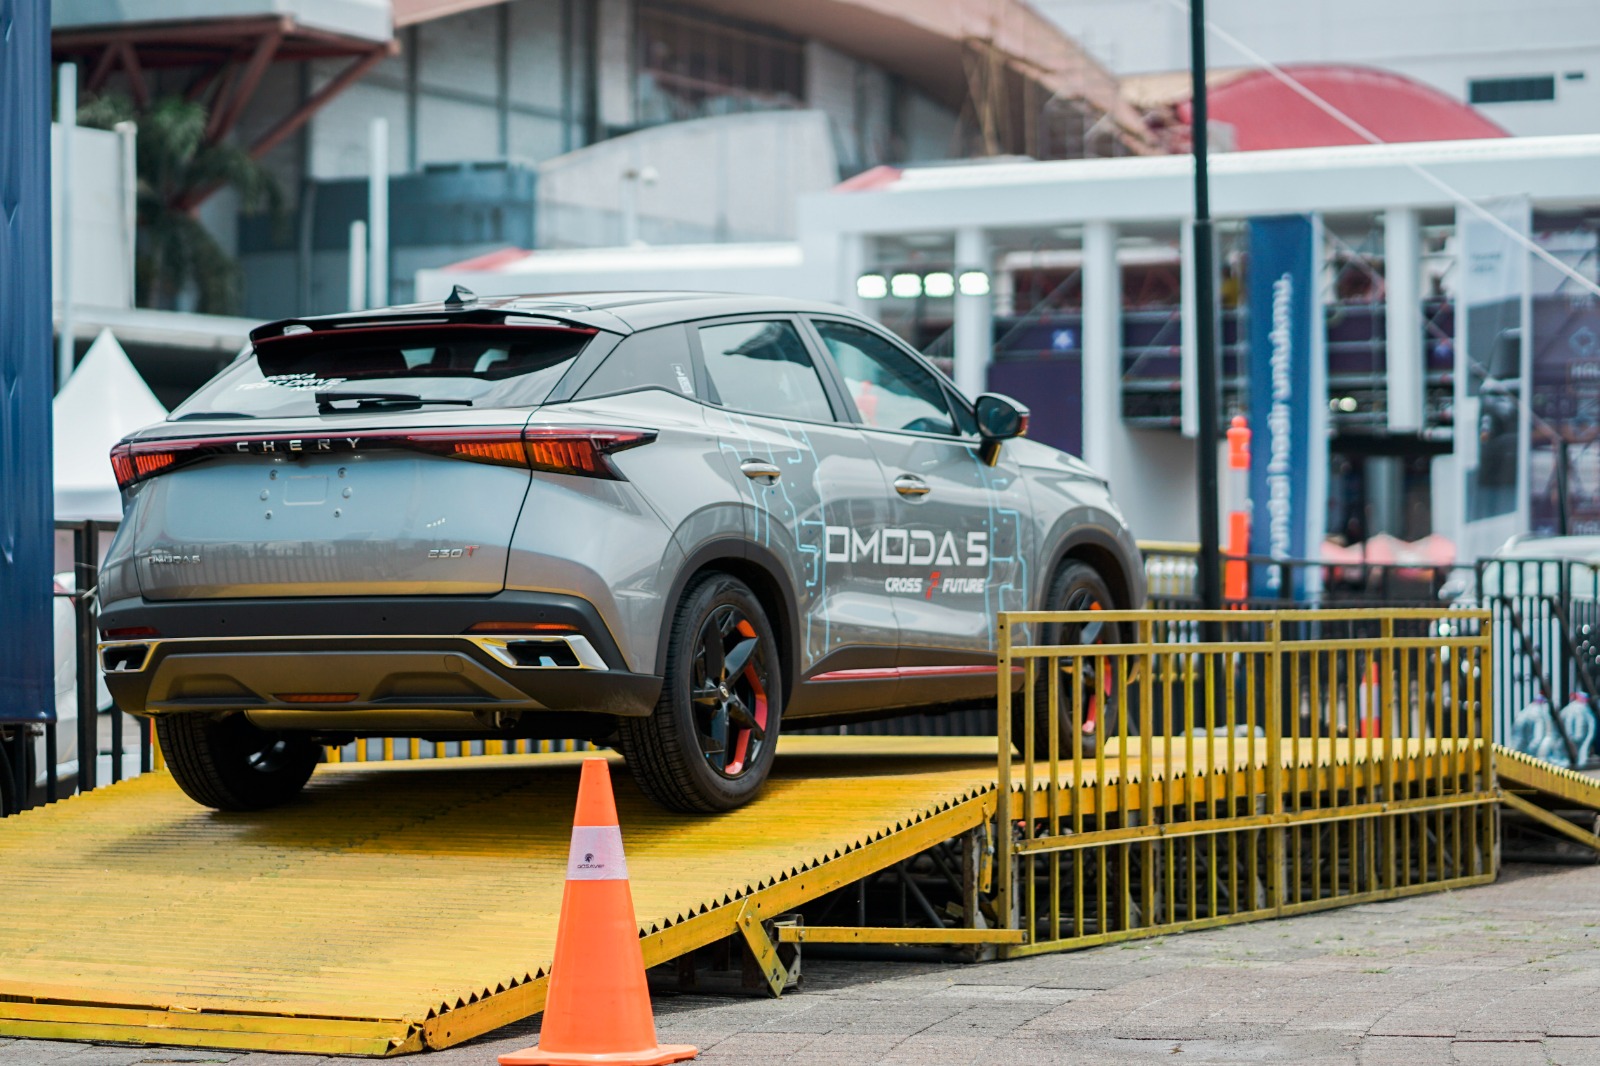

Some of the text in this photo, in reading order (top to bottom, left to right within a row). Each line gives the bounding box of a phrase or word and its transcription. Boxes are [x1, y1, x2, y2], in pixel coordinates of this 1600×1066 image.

[236, 438, 360, 452] CHERY
[826, 526, 961, 566] OMODA
[884, 577, 986, 594] CROSS FUTURE
